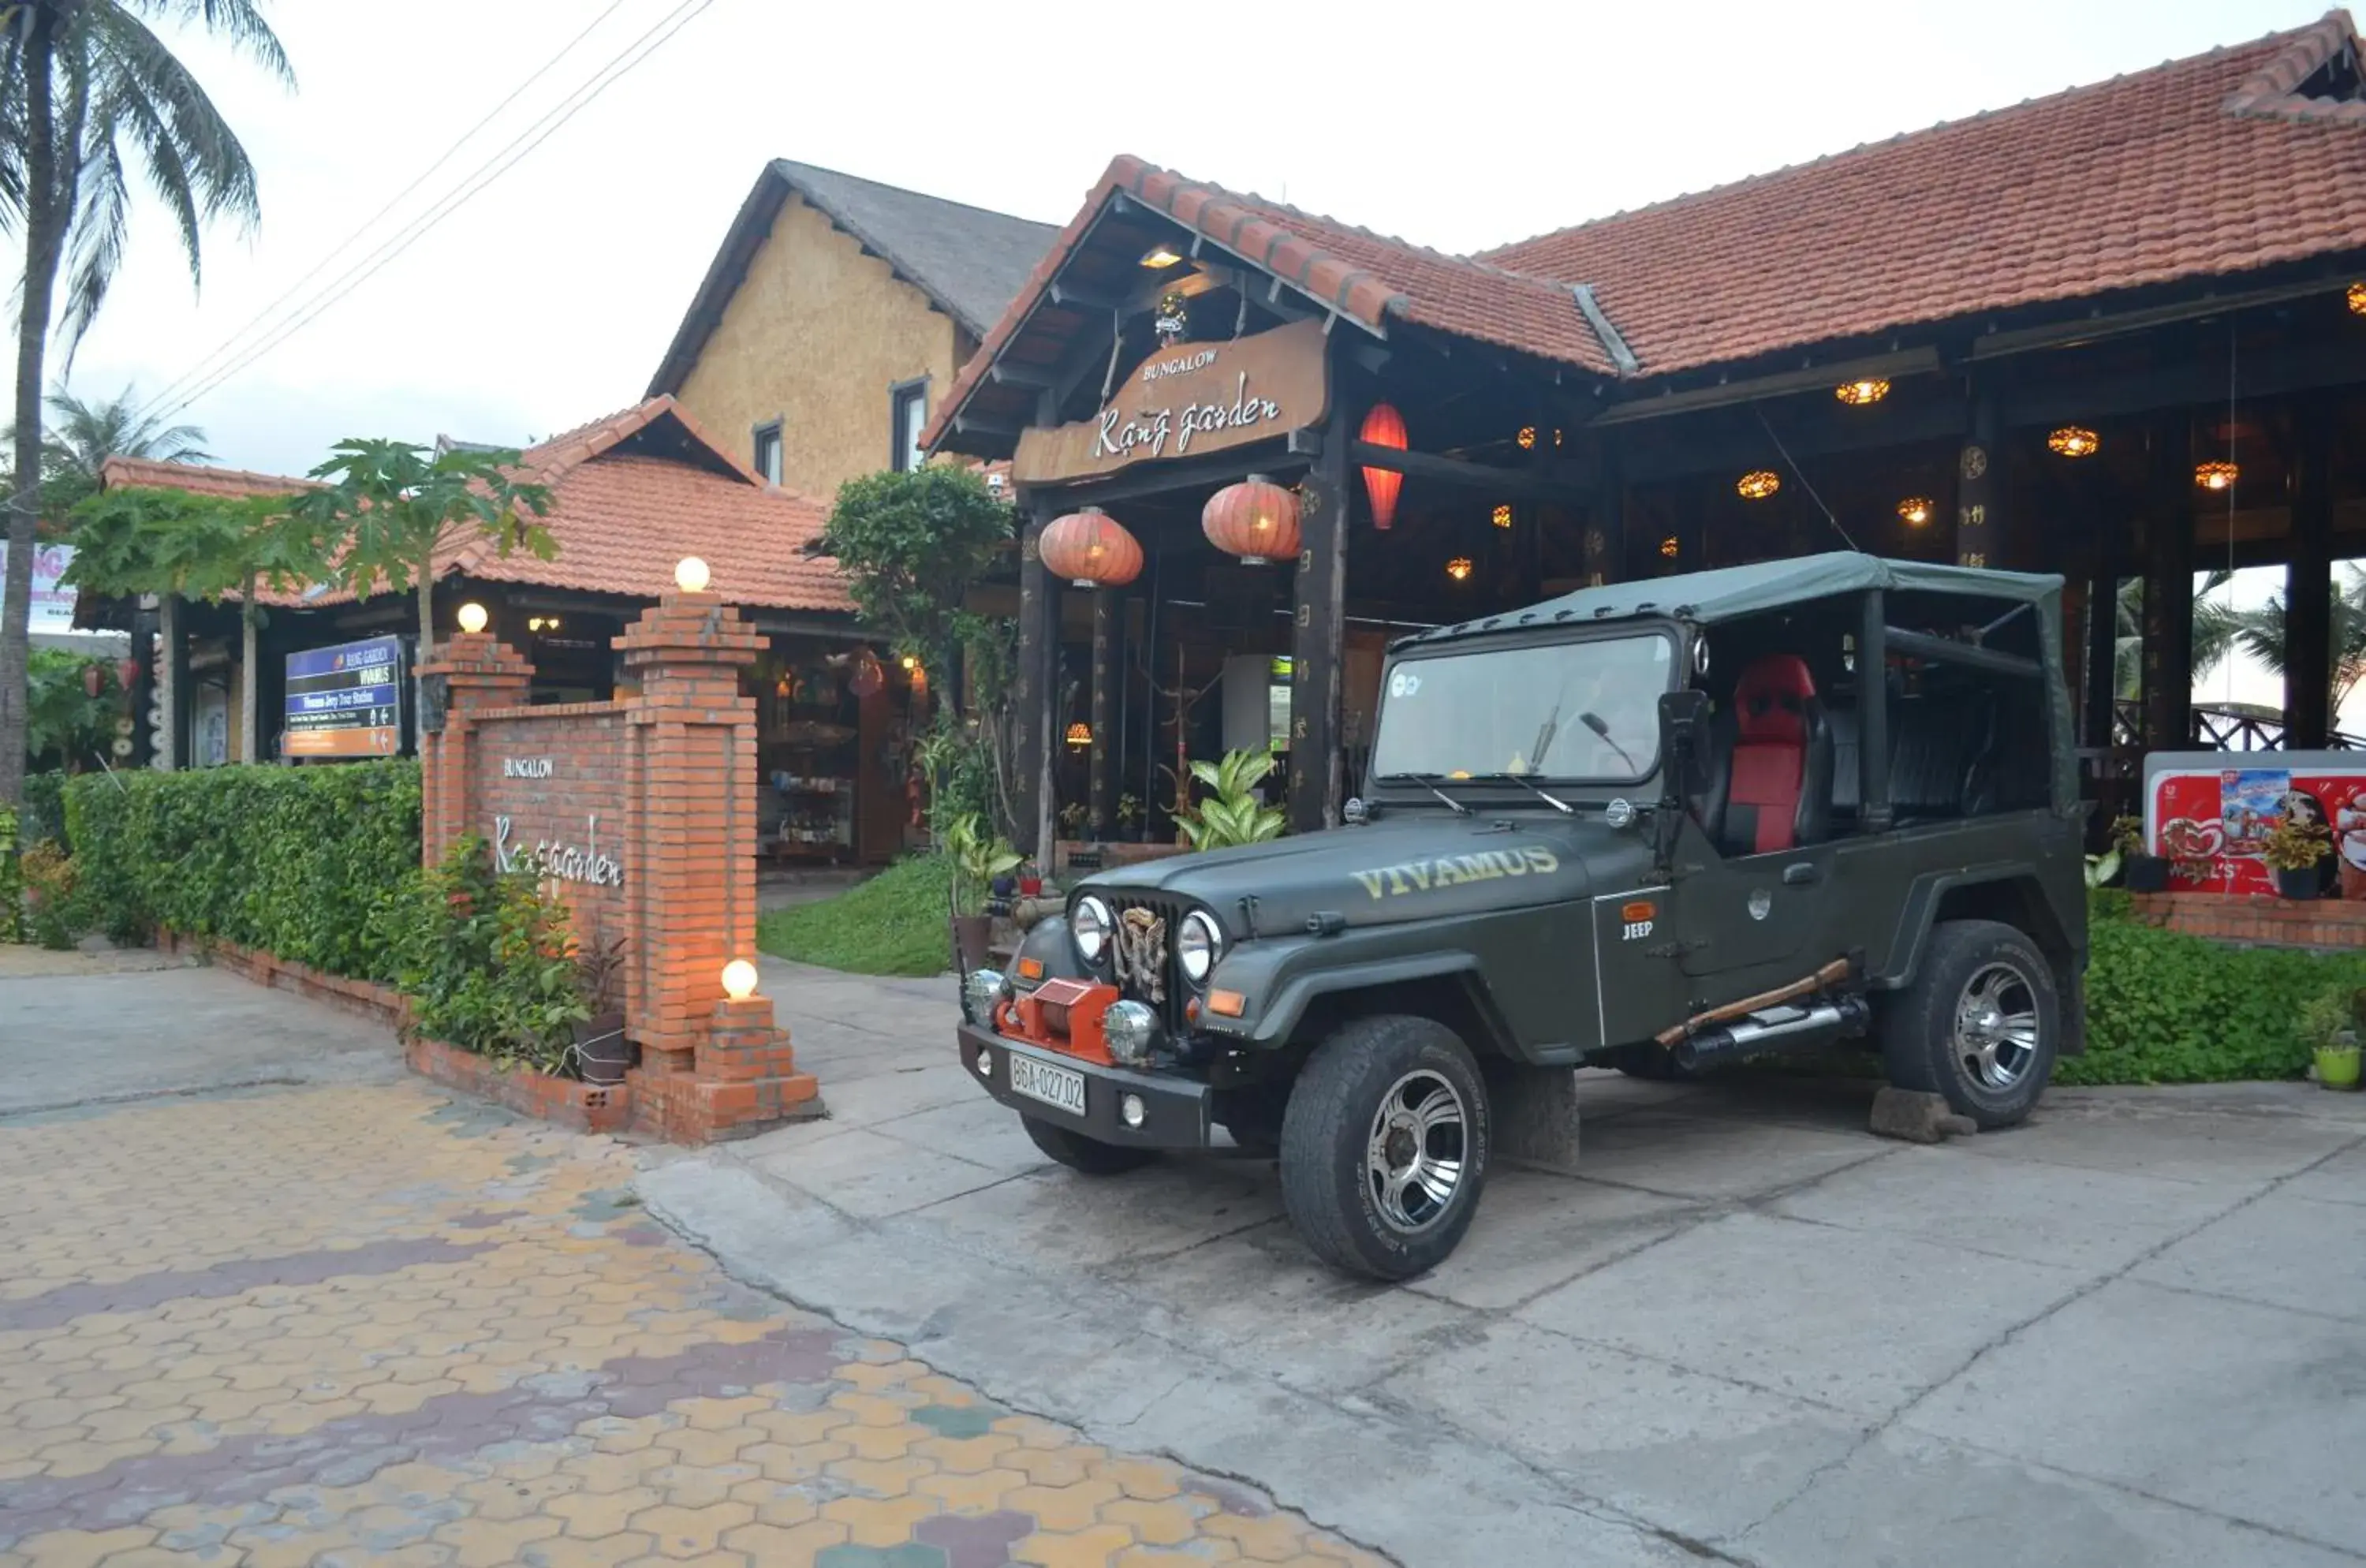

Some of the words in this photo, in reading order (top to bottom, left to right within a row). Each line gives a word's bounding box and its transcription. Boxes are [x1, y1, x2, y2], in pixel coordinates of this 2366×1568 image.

[1143, 349, 1217, 381] BUNGALOW
[1177, 370, 1279, 454] garden
[504, 758, 553, 778] BUNGALOW
[549, 814, 622, 899] garden
[1350, 846, 1559, 900] VIVAMUS
[1622, 920, 1653, 940] JEEP
[1013, 1058, 1083, 1108] 86A-027.02
